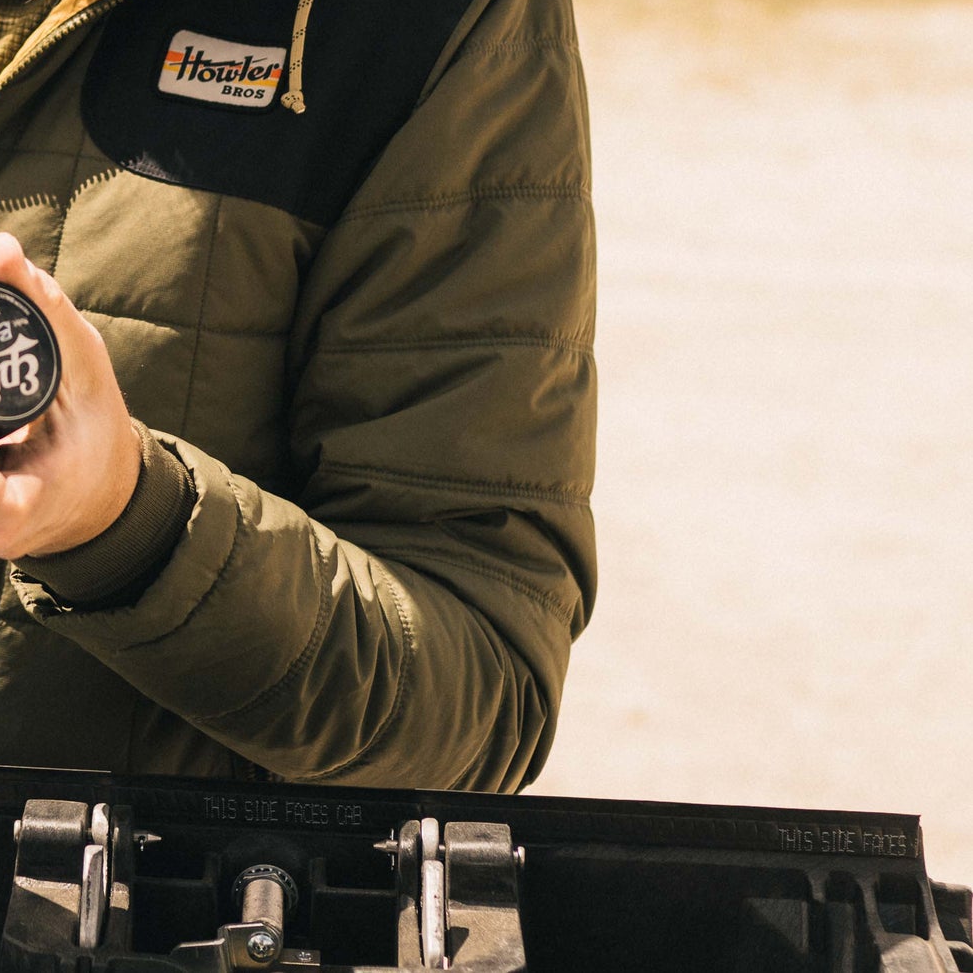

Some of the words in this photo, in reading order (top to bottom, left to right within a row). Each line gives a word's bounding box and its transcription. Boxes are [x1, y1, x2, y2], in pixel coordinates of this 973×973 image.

[169, 46, 279, 83] Howler
[221, 86, 265, 99] BROS
[203, 796, 237, 820] THIS
[244, 799, 278, 822] SIDE
[285, 801, 328, 825] FACES
[337, 804, 363, 825] CAB
[779, 828, 813, 852] THIS
[821, 829, 855, 853] SIDE
[863, 833, 907, 856] FACES
